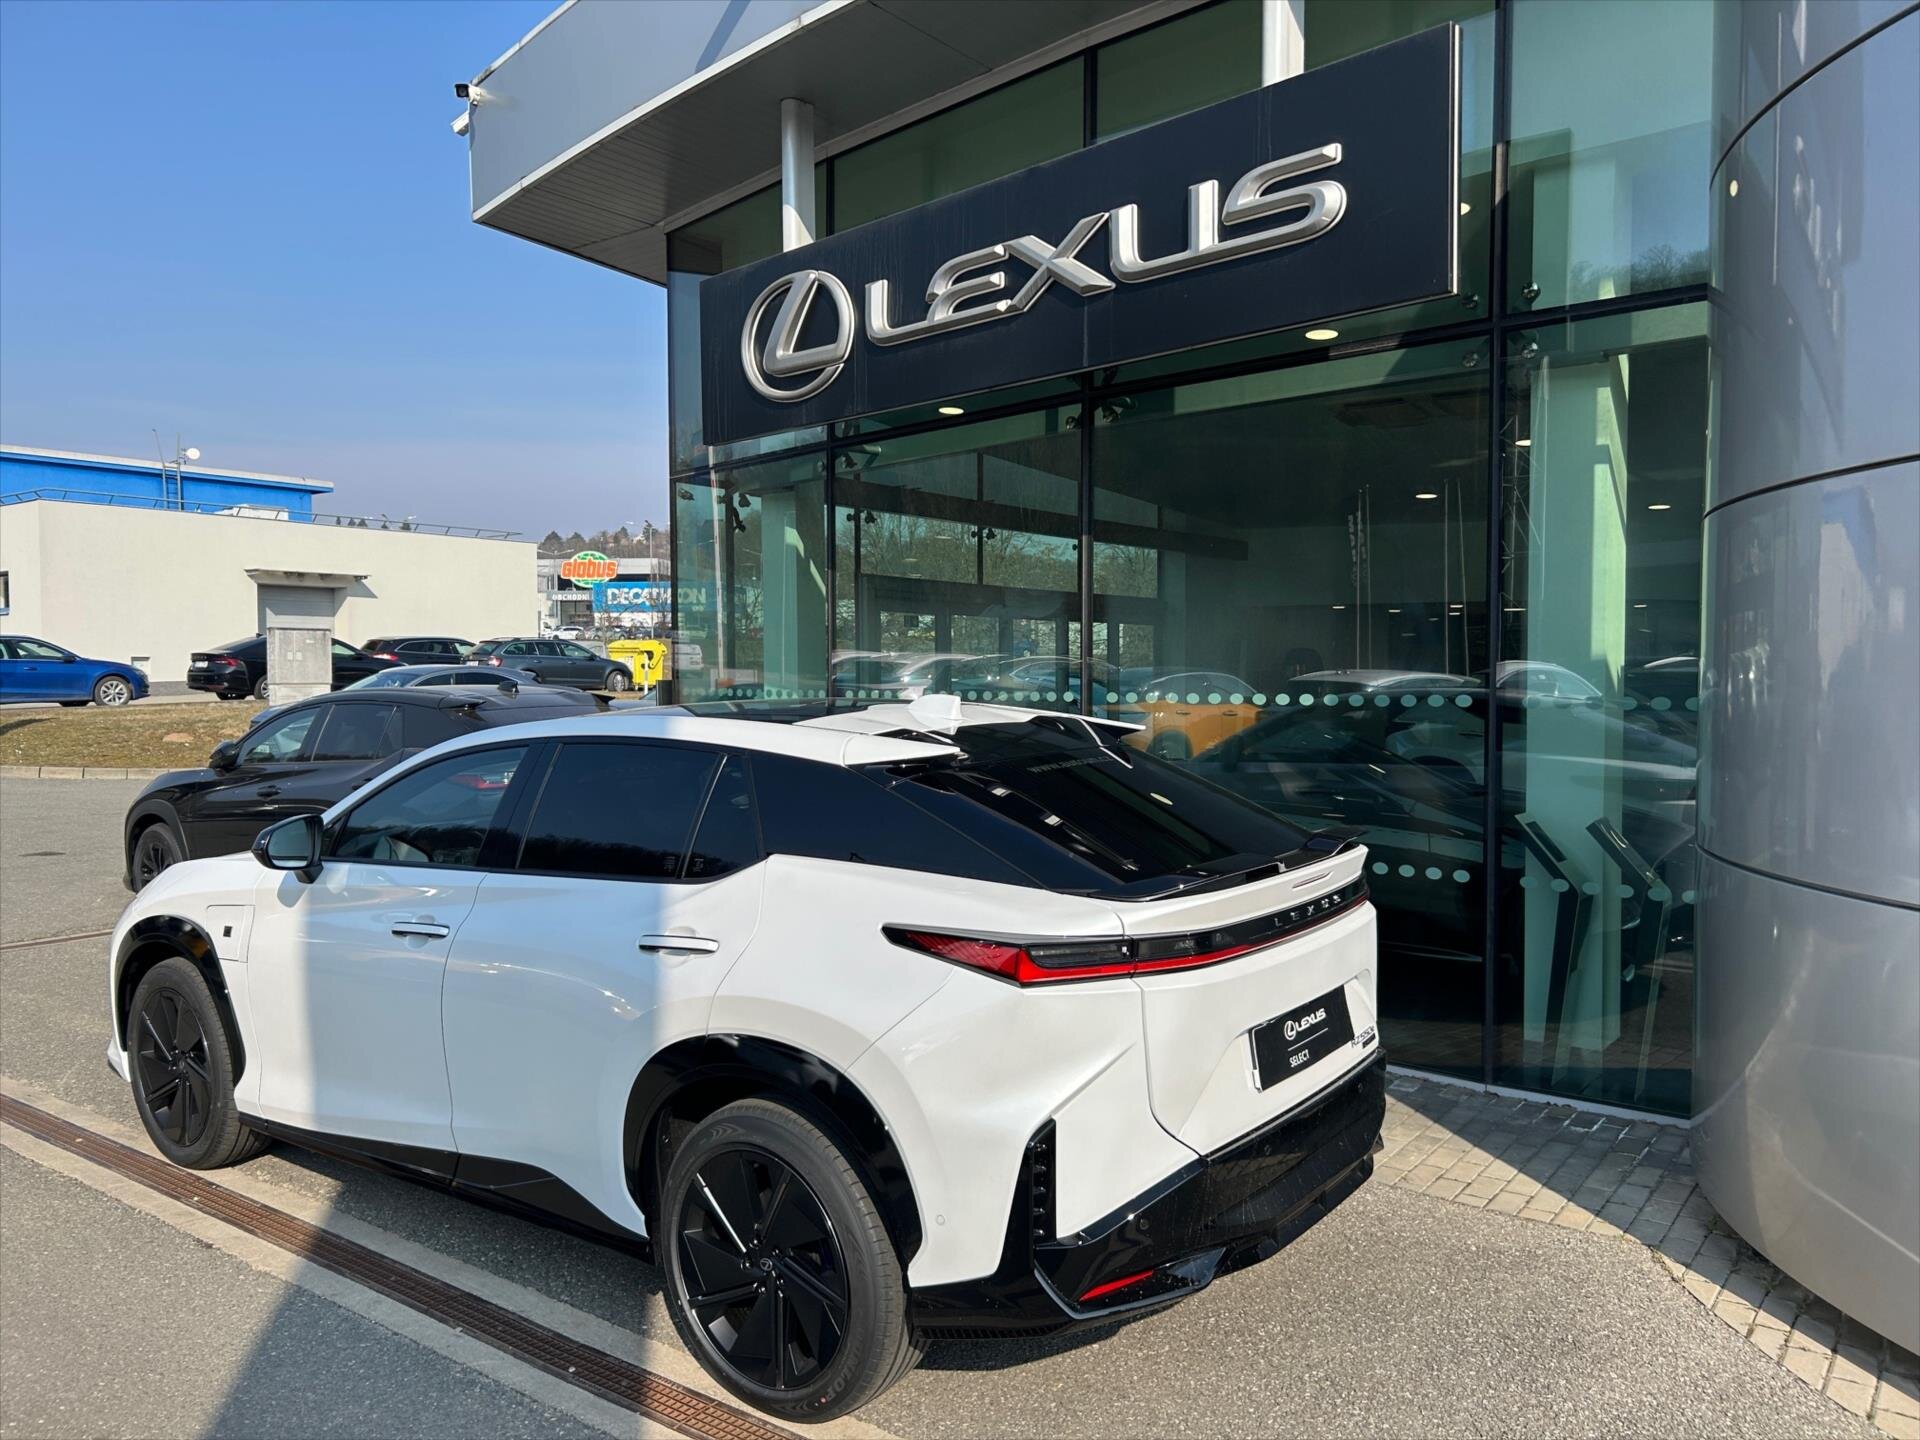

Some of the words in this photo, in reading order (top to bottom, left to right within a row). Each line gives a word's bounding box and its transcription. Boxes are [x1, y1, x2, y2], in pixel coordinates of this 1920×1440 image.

[865, 142, 1348, 346] LEXUS
[1275, 894, 1341, 926] LEXUS
[1296, 1007, 1327, 1030] LEXUS
[1289, 1049, 1310, 1068] SELECT
